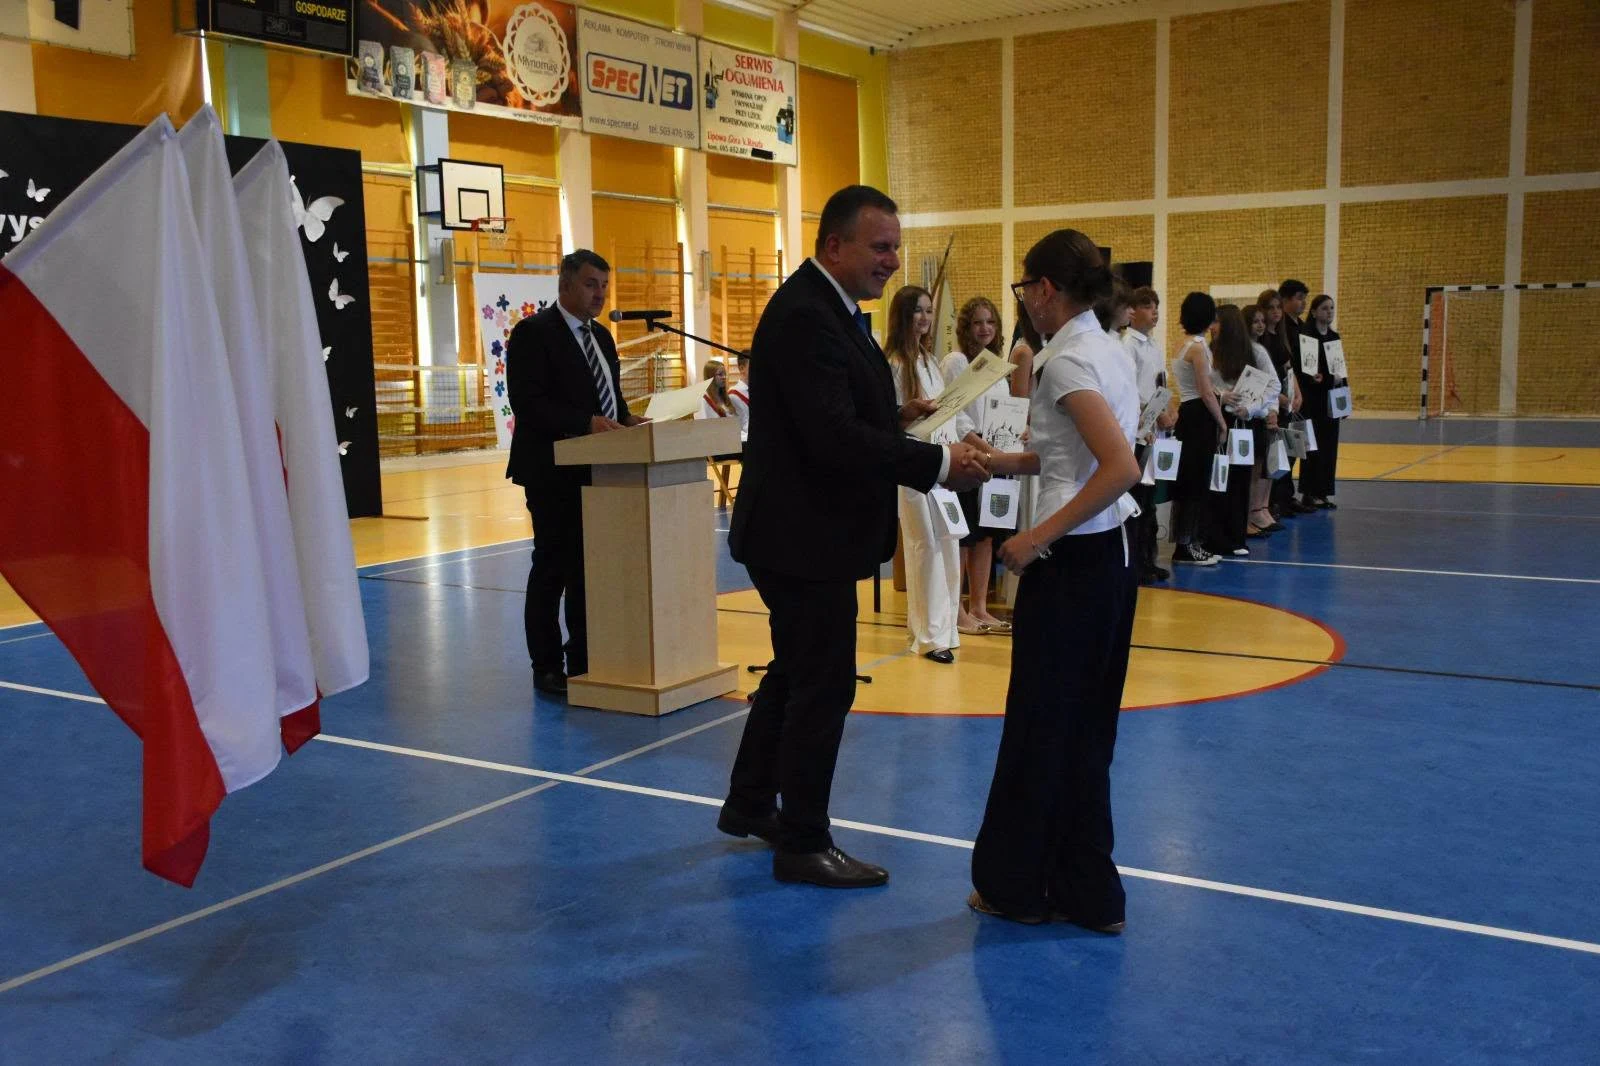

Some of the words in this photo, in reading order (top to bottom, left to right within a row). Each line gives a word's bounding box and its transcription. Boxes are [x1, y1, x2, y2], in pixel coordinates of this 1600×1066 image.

[295, 1, 347, 22] GOSPODARZE
[736, 54, 773, 73] SERWIS
[725, 68, 784, 93] OGUMIENIA
